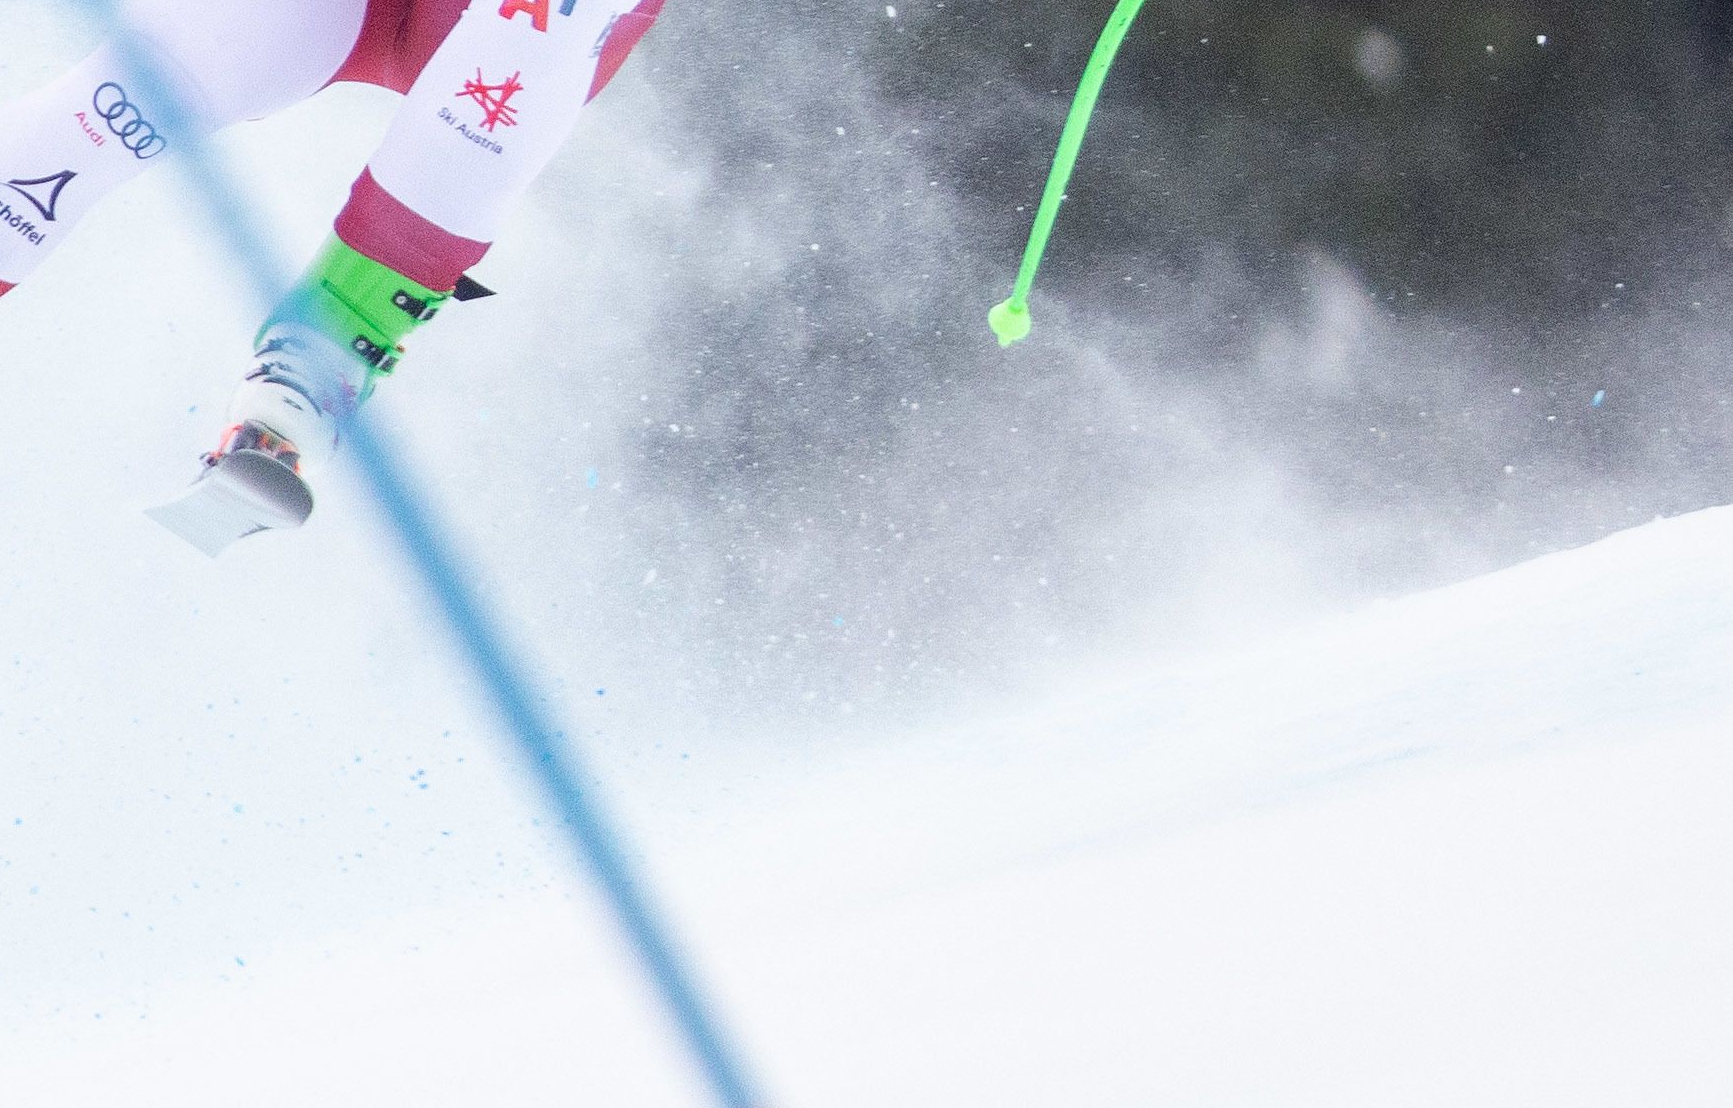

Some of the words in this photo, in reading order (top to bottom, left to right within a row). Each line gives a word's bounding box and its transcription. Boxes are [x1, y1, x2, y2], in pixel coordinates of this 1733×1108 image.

[74, 111, 106, 148] Audi
[437, 106, 455, 127] Ski
[455, 122, 504, 155] Austria
